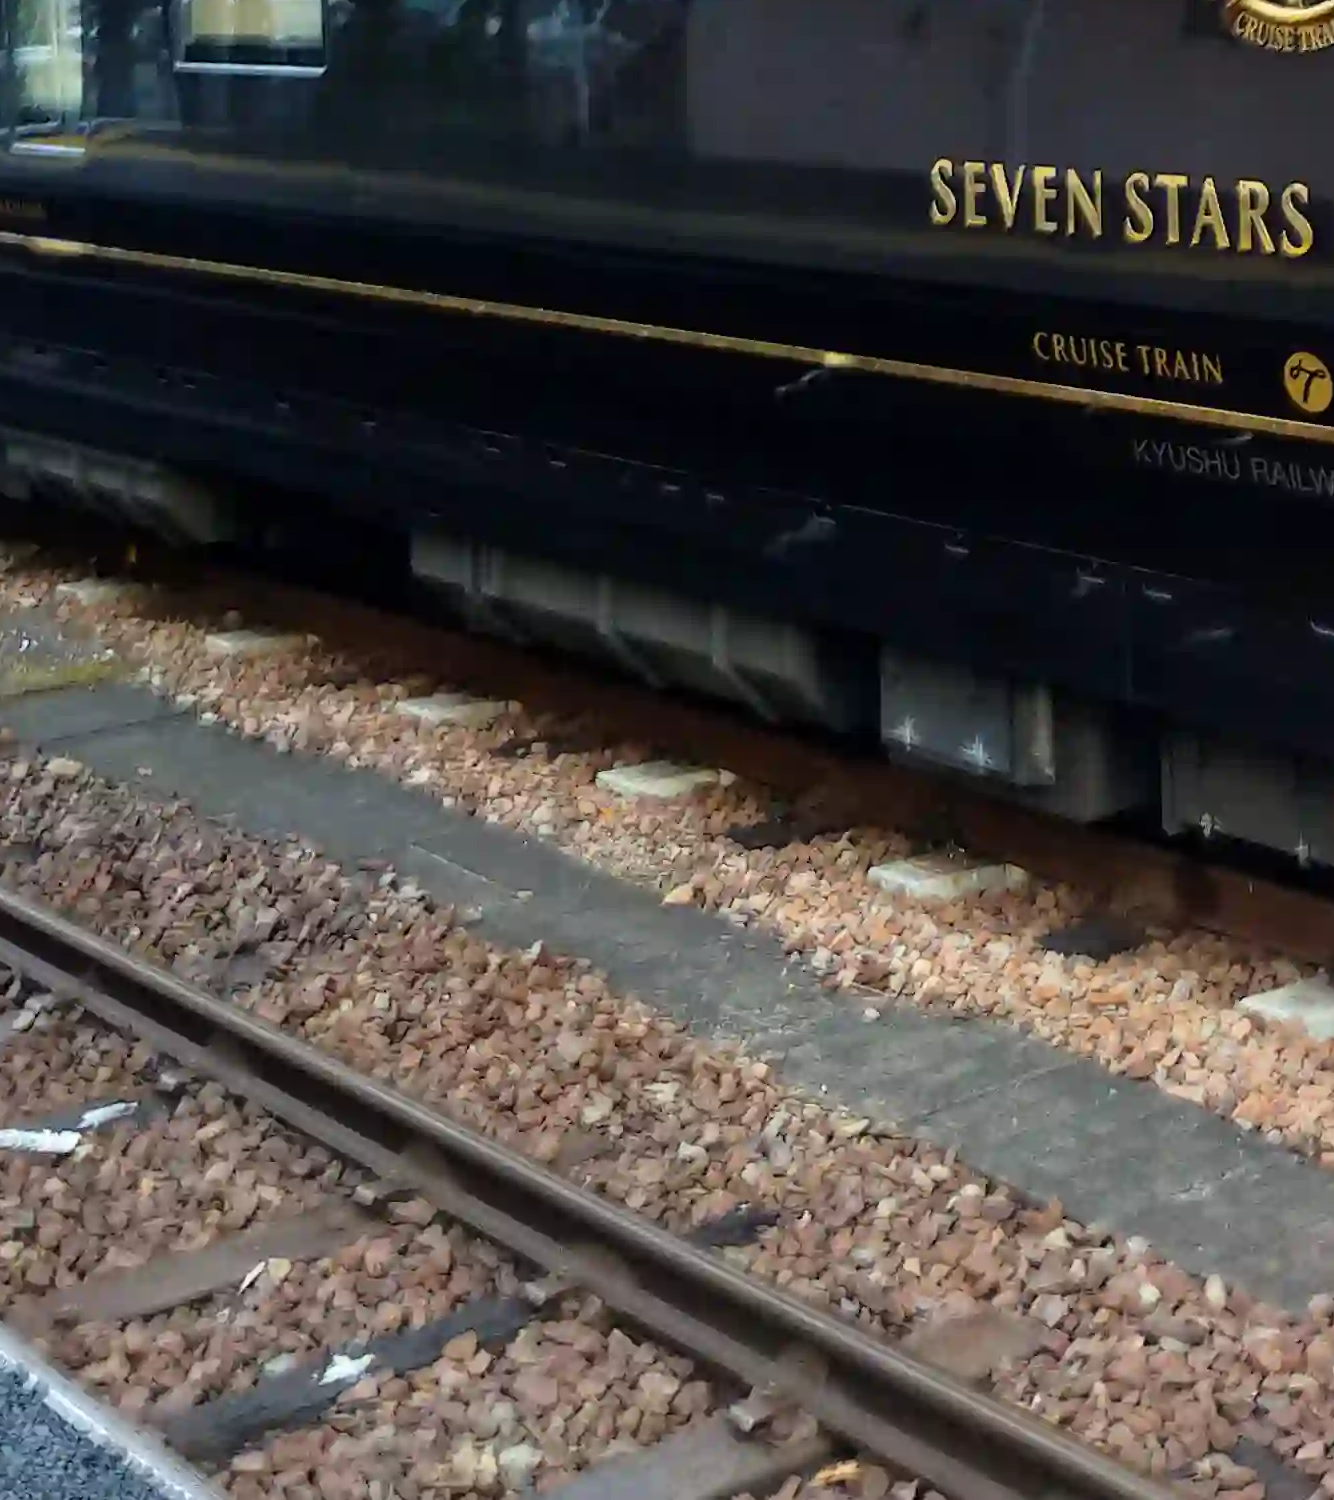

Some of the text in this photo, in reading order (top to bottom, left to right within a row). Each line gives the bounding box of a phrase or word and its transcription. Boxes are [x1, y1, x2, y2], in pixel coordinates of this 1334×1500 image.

[1235, 10, 1296, 52] CRUISE
[929, 157, 1103, 239] SEVEN
[1123, 172, 1315, 259] STARS
[1032, 331, 1224, 385] CRUISE TRAIN
[1133, 438, 1242, 481] KYUSHU
